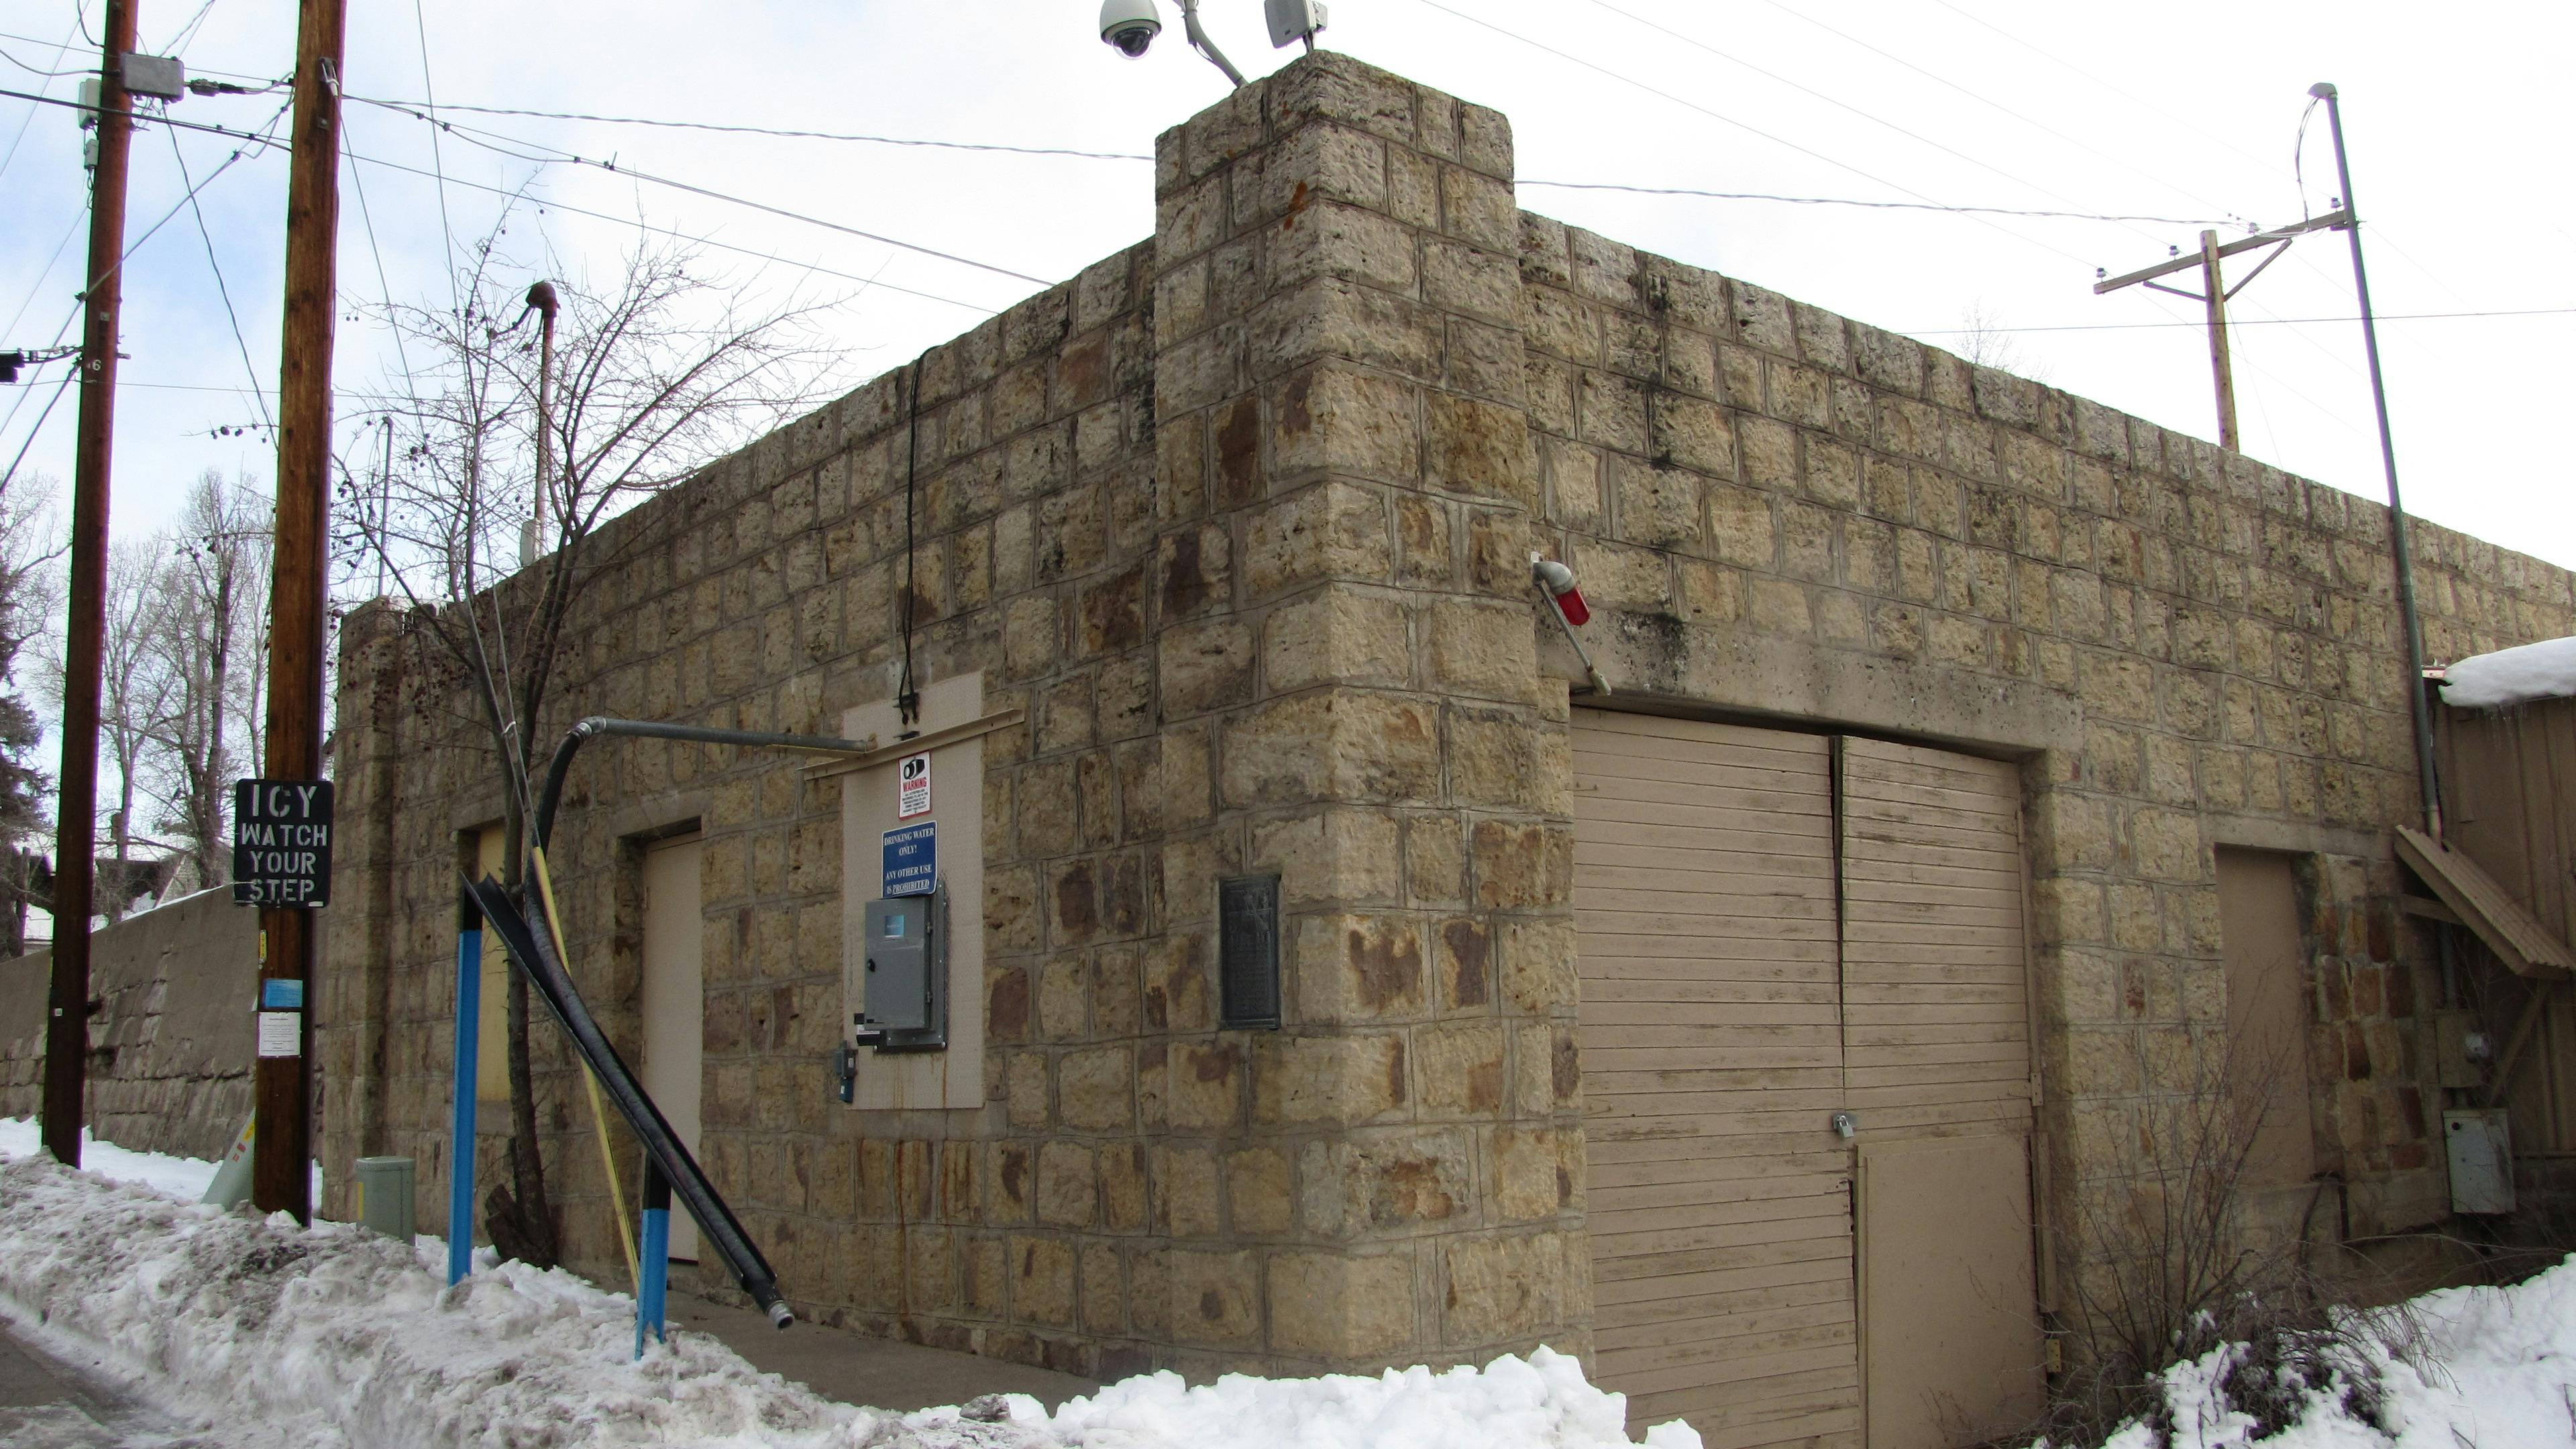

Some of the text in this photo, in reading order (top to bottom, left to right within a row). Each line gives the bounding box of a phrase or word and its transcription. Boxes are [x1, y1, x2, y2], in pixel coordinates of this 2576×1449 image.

[903, 777, 927, 792] WARNING
[252, 784, 317, 818] ICY
[241, 822, 327, 847] WATCH
[884, 827, 934, 845] DRINKING WATER
[899, 845, 918, 856] ONLY!
[250, 851, 317, 874] YOUR
[885, 864, 932, 880] ANY OTHER USE
[249, 879, 315, 902] STEP
[887, 879, 930, 894] IS PROHIBITED
